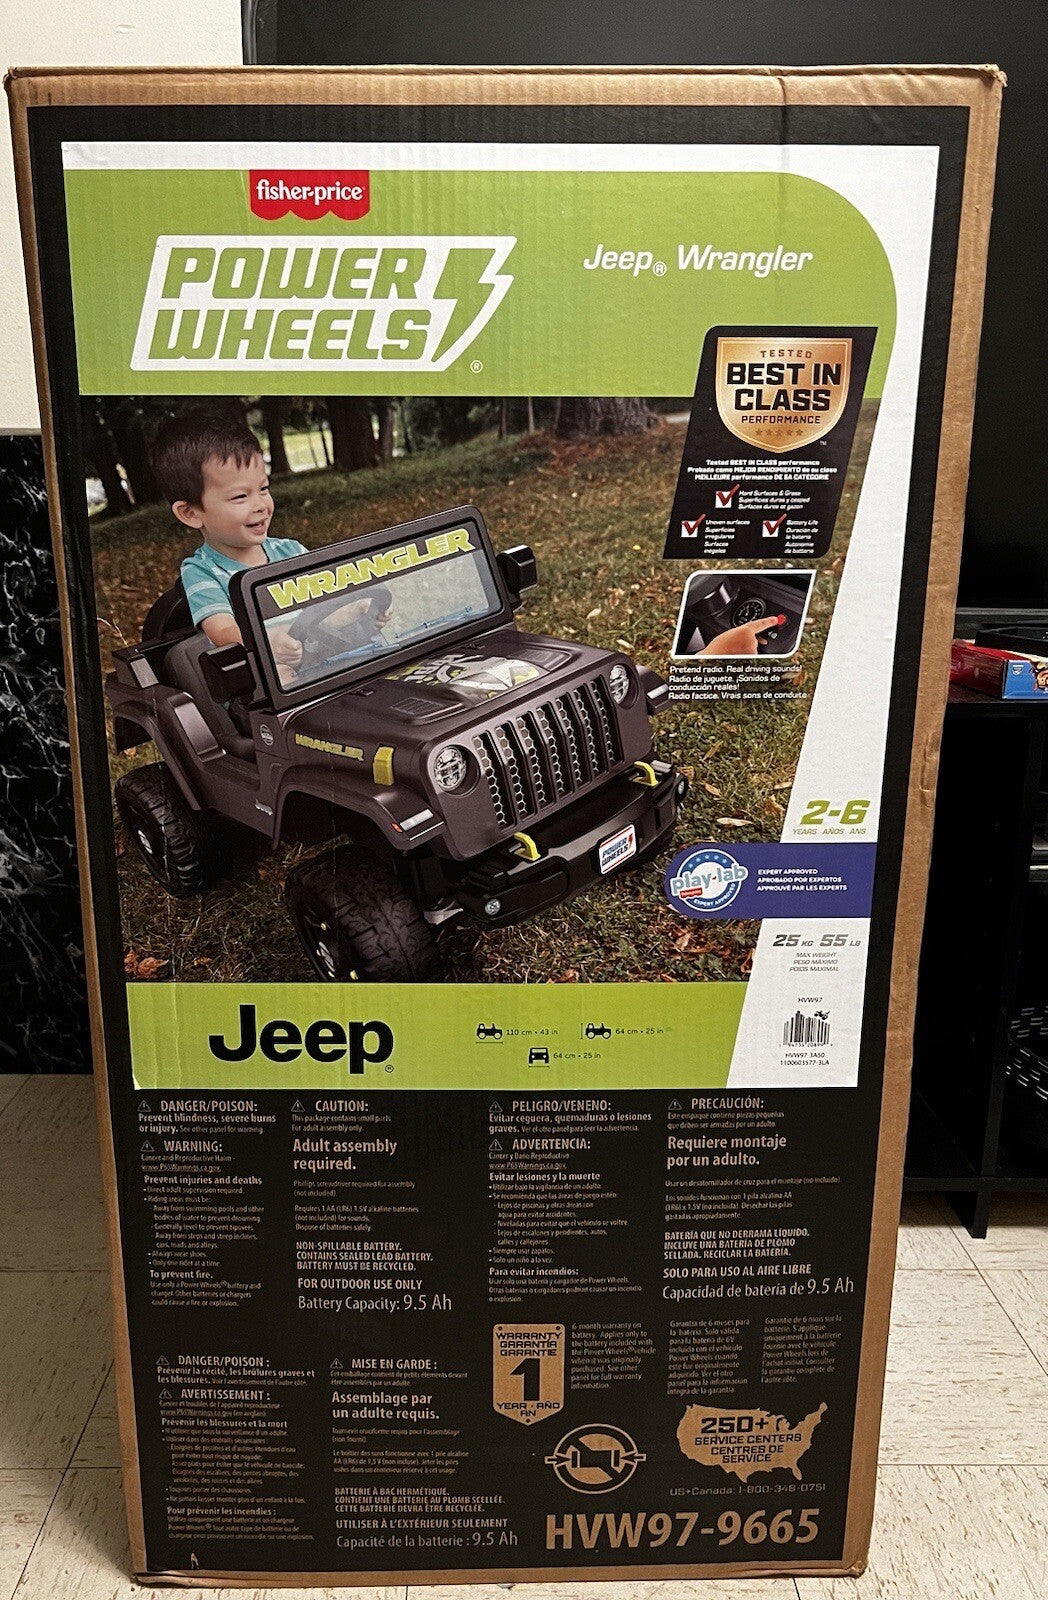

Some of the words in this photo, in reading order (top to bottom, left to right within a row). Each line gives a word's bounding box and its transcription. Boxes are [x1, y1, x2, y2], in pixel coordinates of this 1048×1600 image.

[256, 179, 364, 205] fisher-price
[677, 245, 812, 277] Wrangler
[161, 247, 427, 299] POWER
[148, 309, 432, 360] WHEELS
[760, 350, 812, 358] TESTED
[727, 363, 805, 385] BEST
[813, 363, 841, 385] IN
[734, 389, 830, 411] CLASS
[741, 416, 820, 424] PERFORMANCE
[268, 529, 475, 610] WRANGLER
[745, 666, 770, 674] driving
[704, 676, 734, 684] juguete.
[295, 734, 365, 762] WRANGLER
[800, 800, 870, 824] 2-6
[822, 826, 844, 834] AÑOS
[602, 837, 627, 858] POWER
[602, 846, 628, 866] WHEELS
[773, 934, 801, 947] 25
[820, 934, 849, 946] 55
[208, 1004, 394, 1074] Jeep
[161, 1100, 258, 1112] DANGER/POISON:
[315, 1100, 369, 1112] CAUTION:
[512, 1100, 611, 1112] PELIGRO/VENENO:
[692, 1095, 764, 1109] PRECAUCIÓN:
[139, 1114, 172, 1122] Prevent
[174, 1114, 218, 1123] blindness,
[150, 1124, 178, 1134] injury.
[164, 1141, 222, 1152] WARNING:
[293, 1138, 330, 1152] Adult
[333, 1138, 397, 1155] assembly
[512, 1139, 590, 1150] ADVERTENCIA:
[668, 1136, 727, 1152] Requiere
[731, 1134, 786, 1150] montaje
[294, 1157, 356, 1173] required.
[667, 1156, 689, 1170] por
[693, 1156, 709, 1166] un
[713, 1152, 759, 1166] adulto.
[144, 1175, 178, 1184] Prevent
[180, 1176, 212, 1185] injuries
[214, 1176, 230, 1184] and
[232, 1176, 262, 1184] deaths
[296, 1242, 361, 1250] NON-SPILLABLE
[364, 1242, 402, 1251] BATTERY.
[663, 1268, 688, 1278] SOLO
[692, 1267, 717, 1277] PARA
[721, 1266, 740, 1276] USO
[743, 1266, 754, 1276] AL
[757, 1265, 780, 1275] AIRE
[783, 1264, 811, 1274] LIBRE
[298, 1279, 317, 1288] FOR
[320, 1279, 370, 1289] OUTDOOR
[374, 1280, 392, 1289] USE
[395, 1280, 423, 1290] ONLY
[663, 1285, 723, 1302] Capacidad
[727, 1284, 741, 1297] de
[745, 1284, 786, 1297] batería
[790, 1282, 804, 1295] de
[807, 1278, 830, 1294] 9.5
[835, 1277, 854, 1293] Ah
[298, 1296, 342, 1312] Battery
[345, 1297, 400, 1312] Capacity:
[404, 1295, 427, 1310] 9.5
[432, 1294, 452, 1310] Ah
[178, 1356, 263, 1367] DANGER/POISON
[352, 1359, 377, 1369] MISE
[380, 1359, 393, 1369] EN
[397, 1359, 431, 1369] GARDE
[510, 1358, 540, 1401] 1
[181, 1389, 264, 1400] AVERTISSEMENT
[332, 1391, 408, 1406] Assemblage
[411, 1394, 432, 1406] par
[333, 1409, 348, 1418] un
[352, 1407, 394, 1419] adulte
[397, 1408, 439, 1422] requis.
[701, 1417, 769, 1433] 250+
[695, 1436, 744, 1445] SERVICE
[747, 1434, 802, 1442] CENTERS
[711, 1446, 764, 1455] CENTRES
[722, 1454, 772, 1463] SERVICE
[739, 1484, 826, 1494] 1-800-348-0751
[546, 1509, 820, 1550] HVW97-9665
[337, 1536, 384, 1550] Capacité
[388, 1535, 401, 1546] de
[406, 1535, 414, 1546] la
[419, 1536, 463, 1546] batterie
[472, 1532, 494, 1545] 9.5
[499, 1531, 518, 1545] Ah
